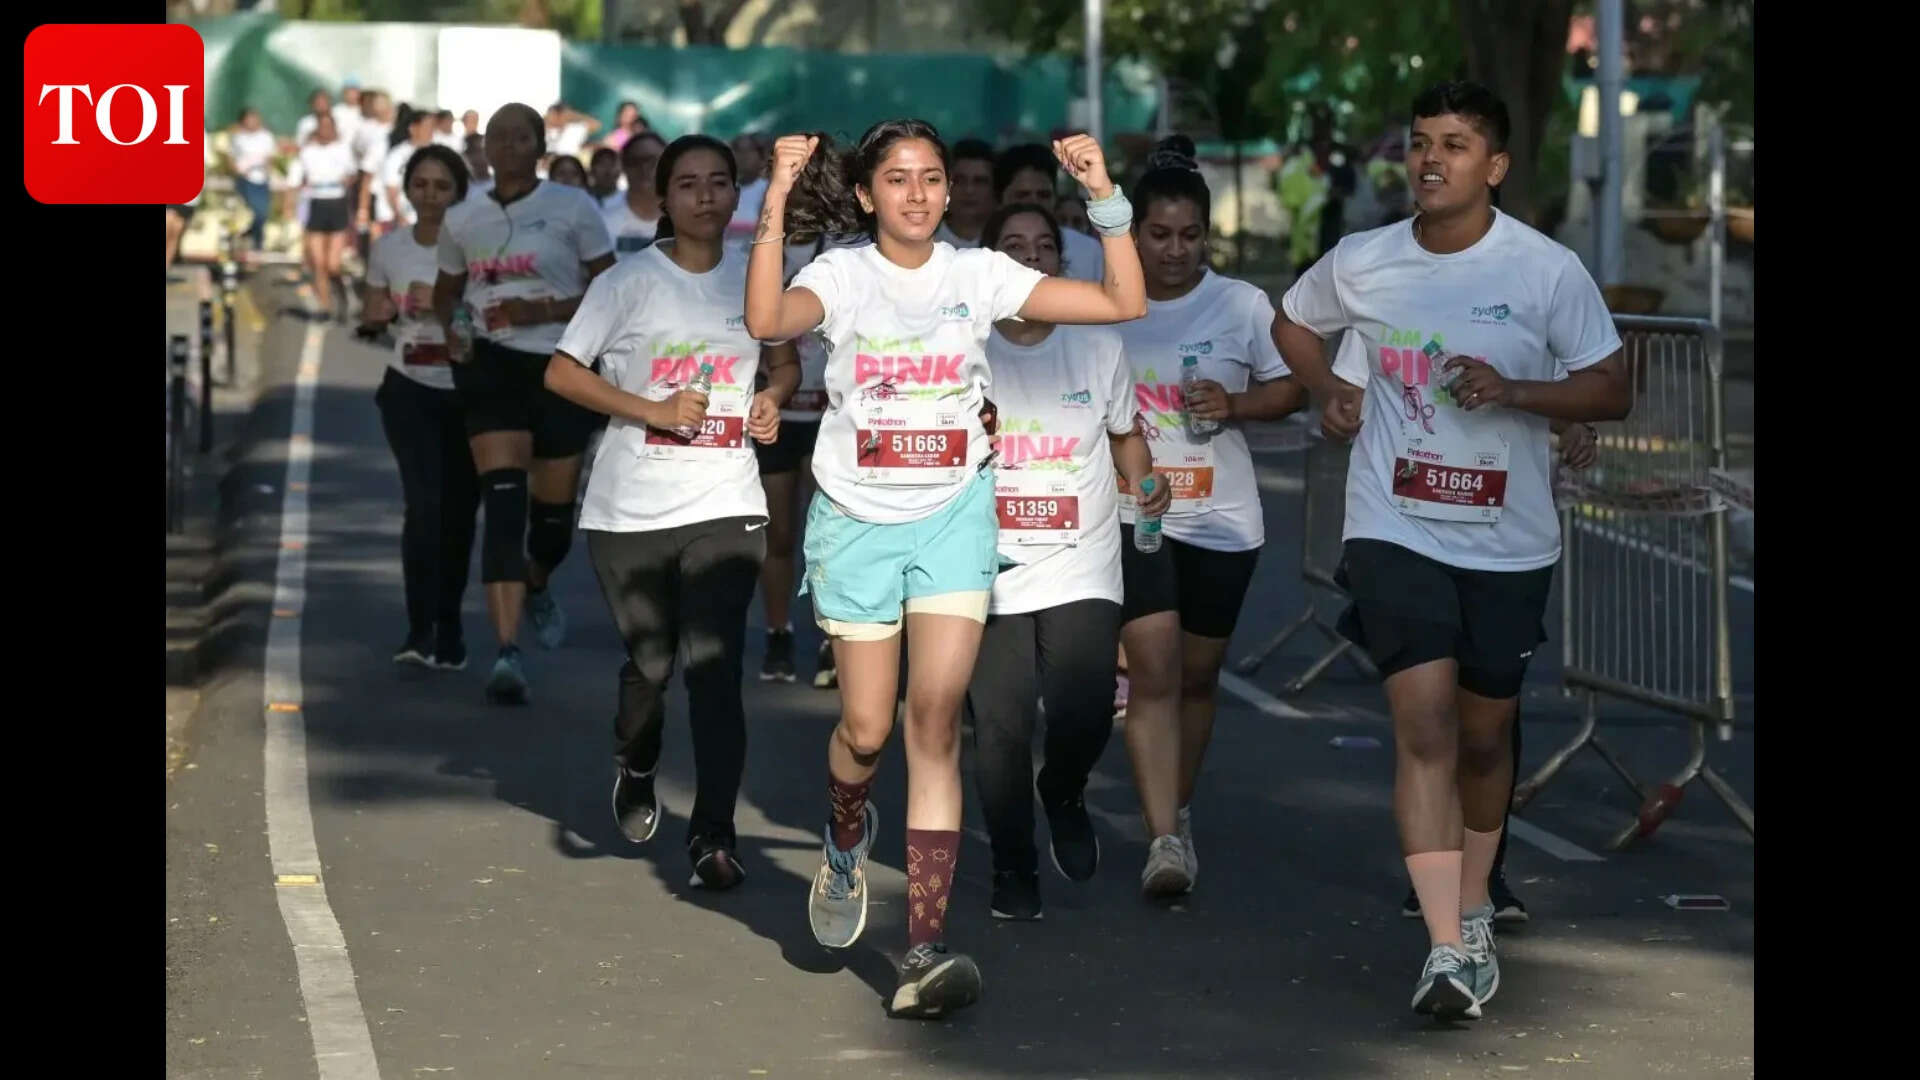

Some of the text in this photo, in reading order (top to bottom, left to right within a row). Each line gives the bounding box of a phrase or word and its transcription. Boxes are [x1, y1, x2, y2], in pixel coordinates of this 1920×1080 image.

[1471, 303, 1511, 320] zydus
[650, 355, 741, 385] PINK
[855, 353, 966, 385] PINK
[700, 420, 725, 435] 420
[892, 434, 948, 453] 51663
[1184, 456, 1206, 464] 10km
[1167, 471, 1195, 487] 028
[1426, 469, 1484, 491] 51664
[1006, 500, 1058, 517] 51359
